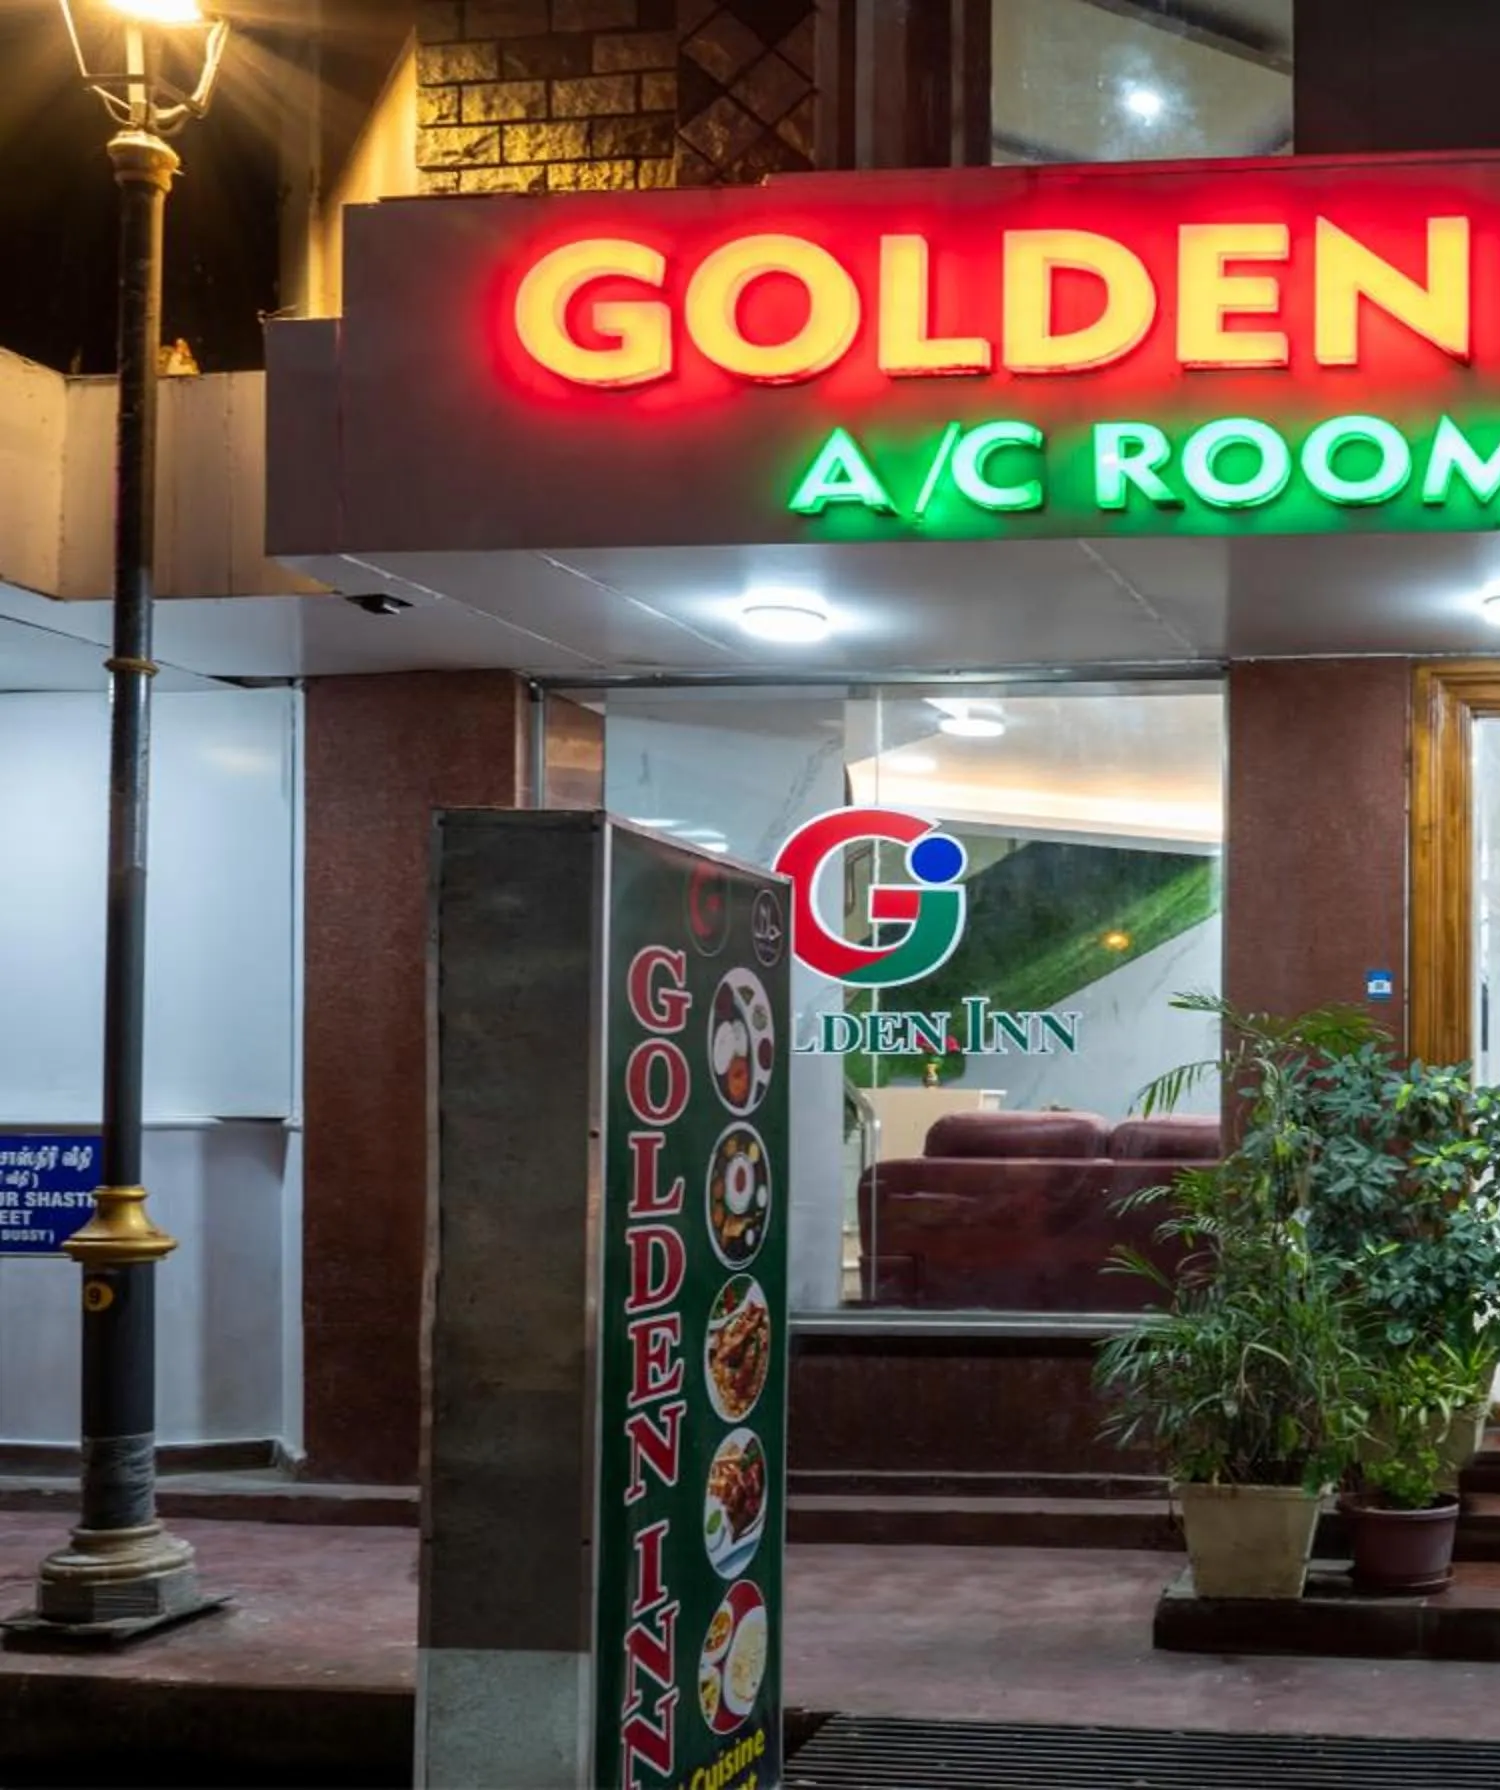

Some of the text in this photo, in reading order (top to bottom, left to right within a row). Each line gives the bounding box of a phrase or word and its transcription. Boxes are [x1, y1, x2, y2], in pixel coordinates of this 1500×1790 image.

[514, 214, 1471, 386] GOLDEN
[789, 420, 1044, 523] A/C
[962, 997, 1083, 1055] INN
[621, 944, 692, 1790] GOLDEN INN
